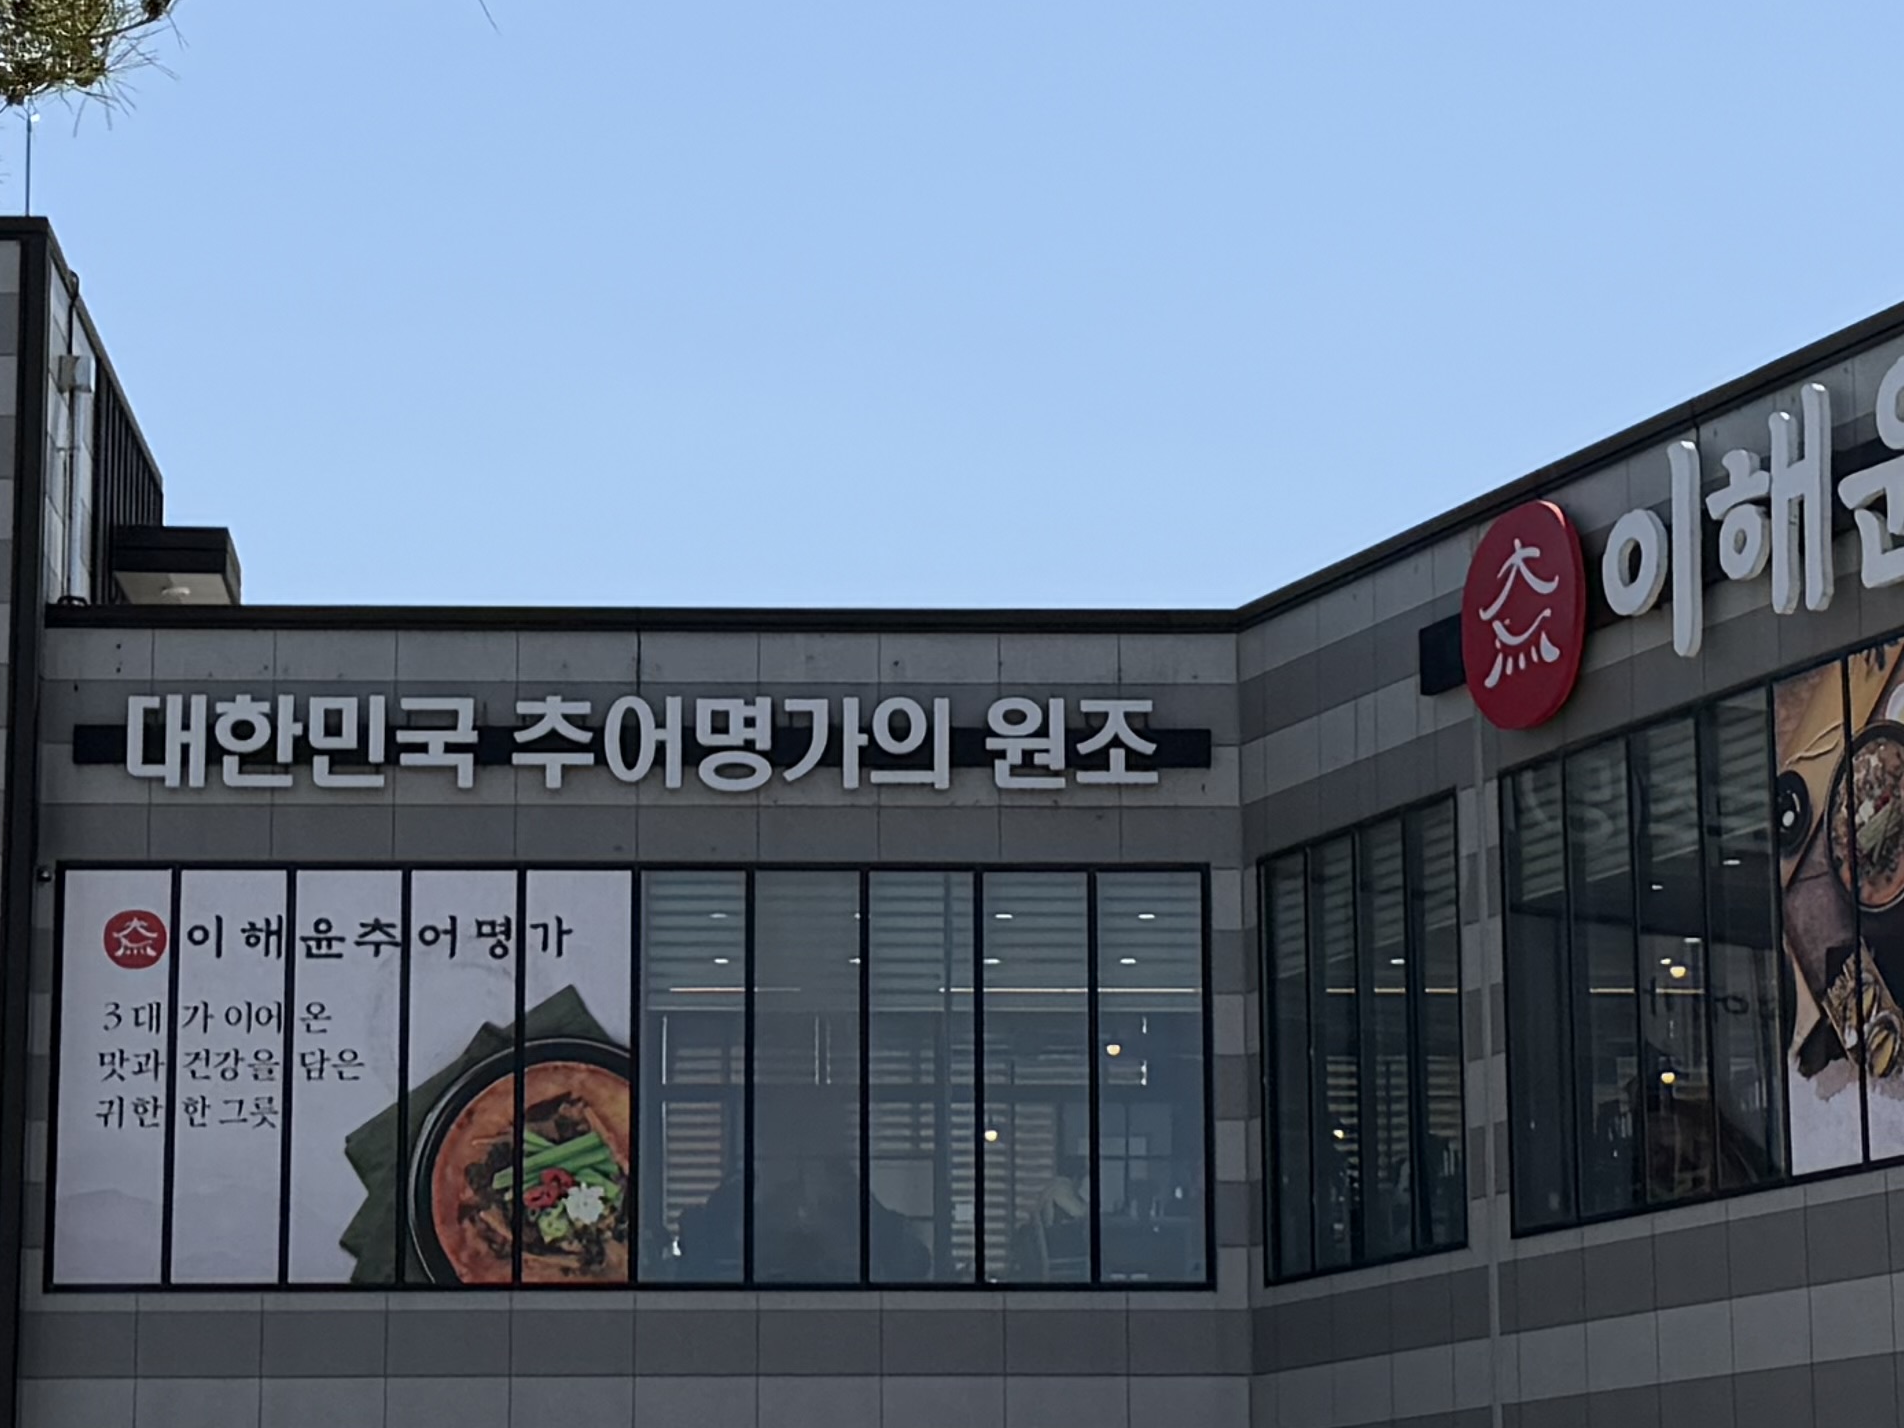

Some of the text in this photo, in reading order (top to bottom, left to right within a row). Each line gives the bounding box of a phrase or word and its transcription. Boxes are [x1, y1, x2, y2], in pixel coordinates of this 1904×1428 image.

[125, 693, 1160, 792] 대한민국 추어명가의 원조
[224, 1001, 333, 1034] 이어온
[98, 1047, 366, 1083] 맛과 건강을 담은
[95, 1095, 163, 1130] 귀한
